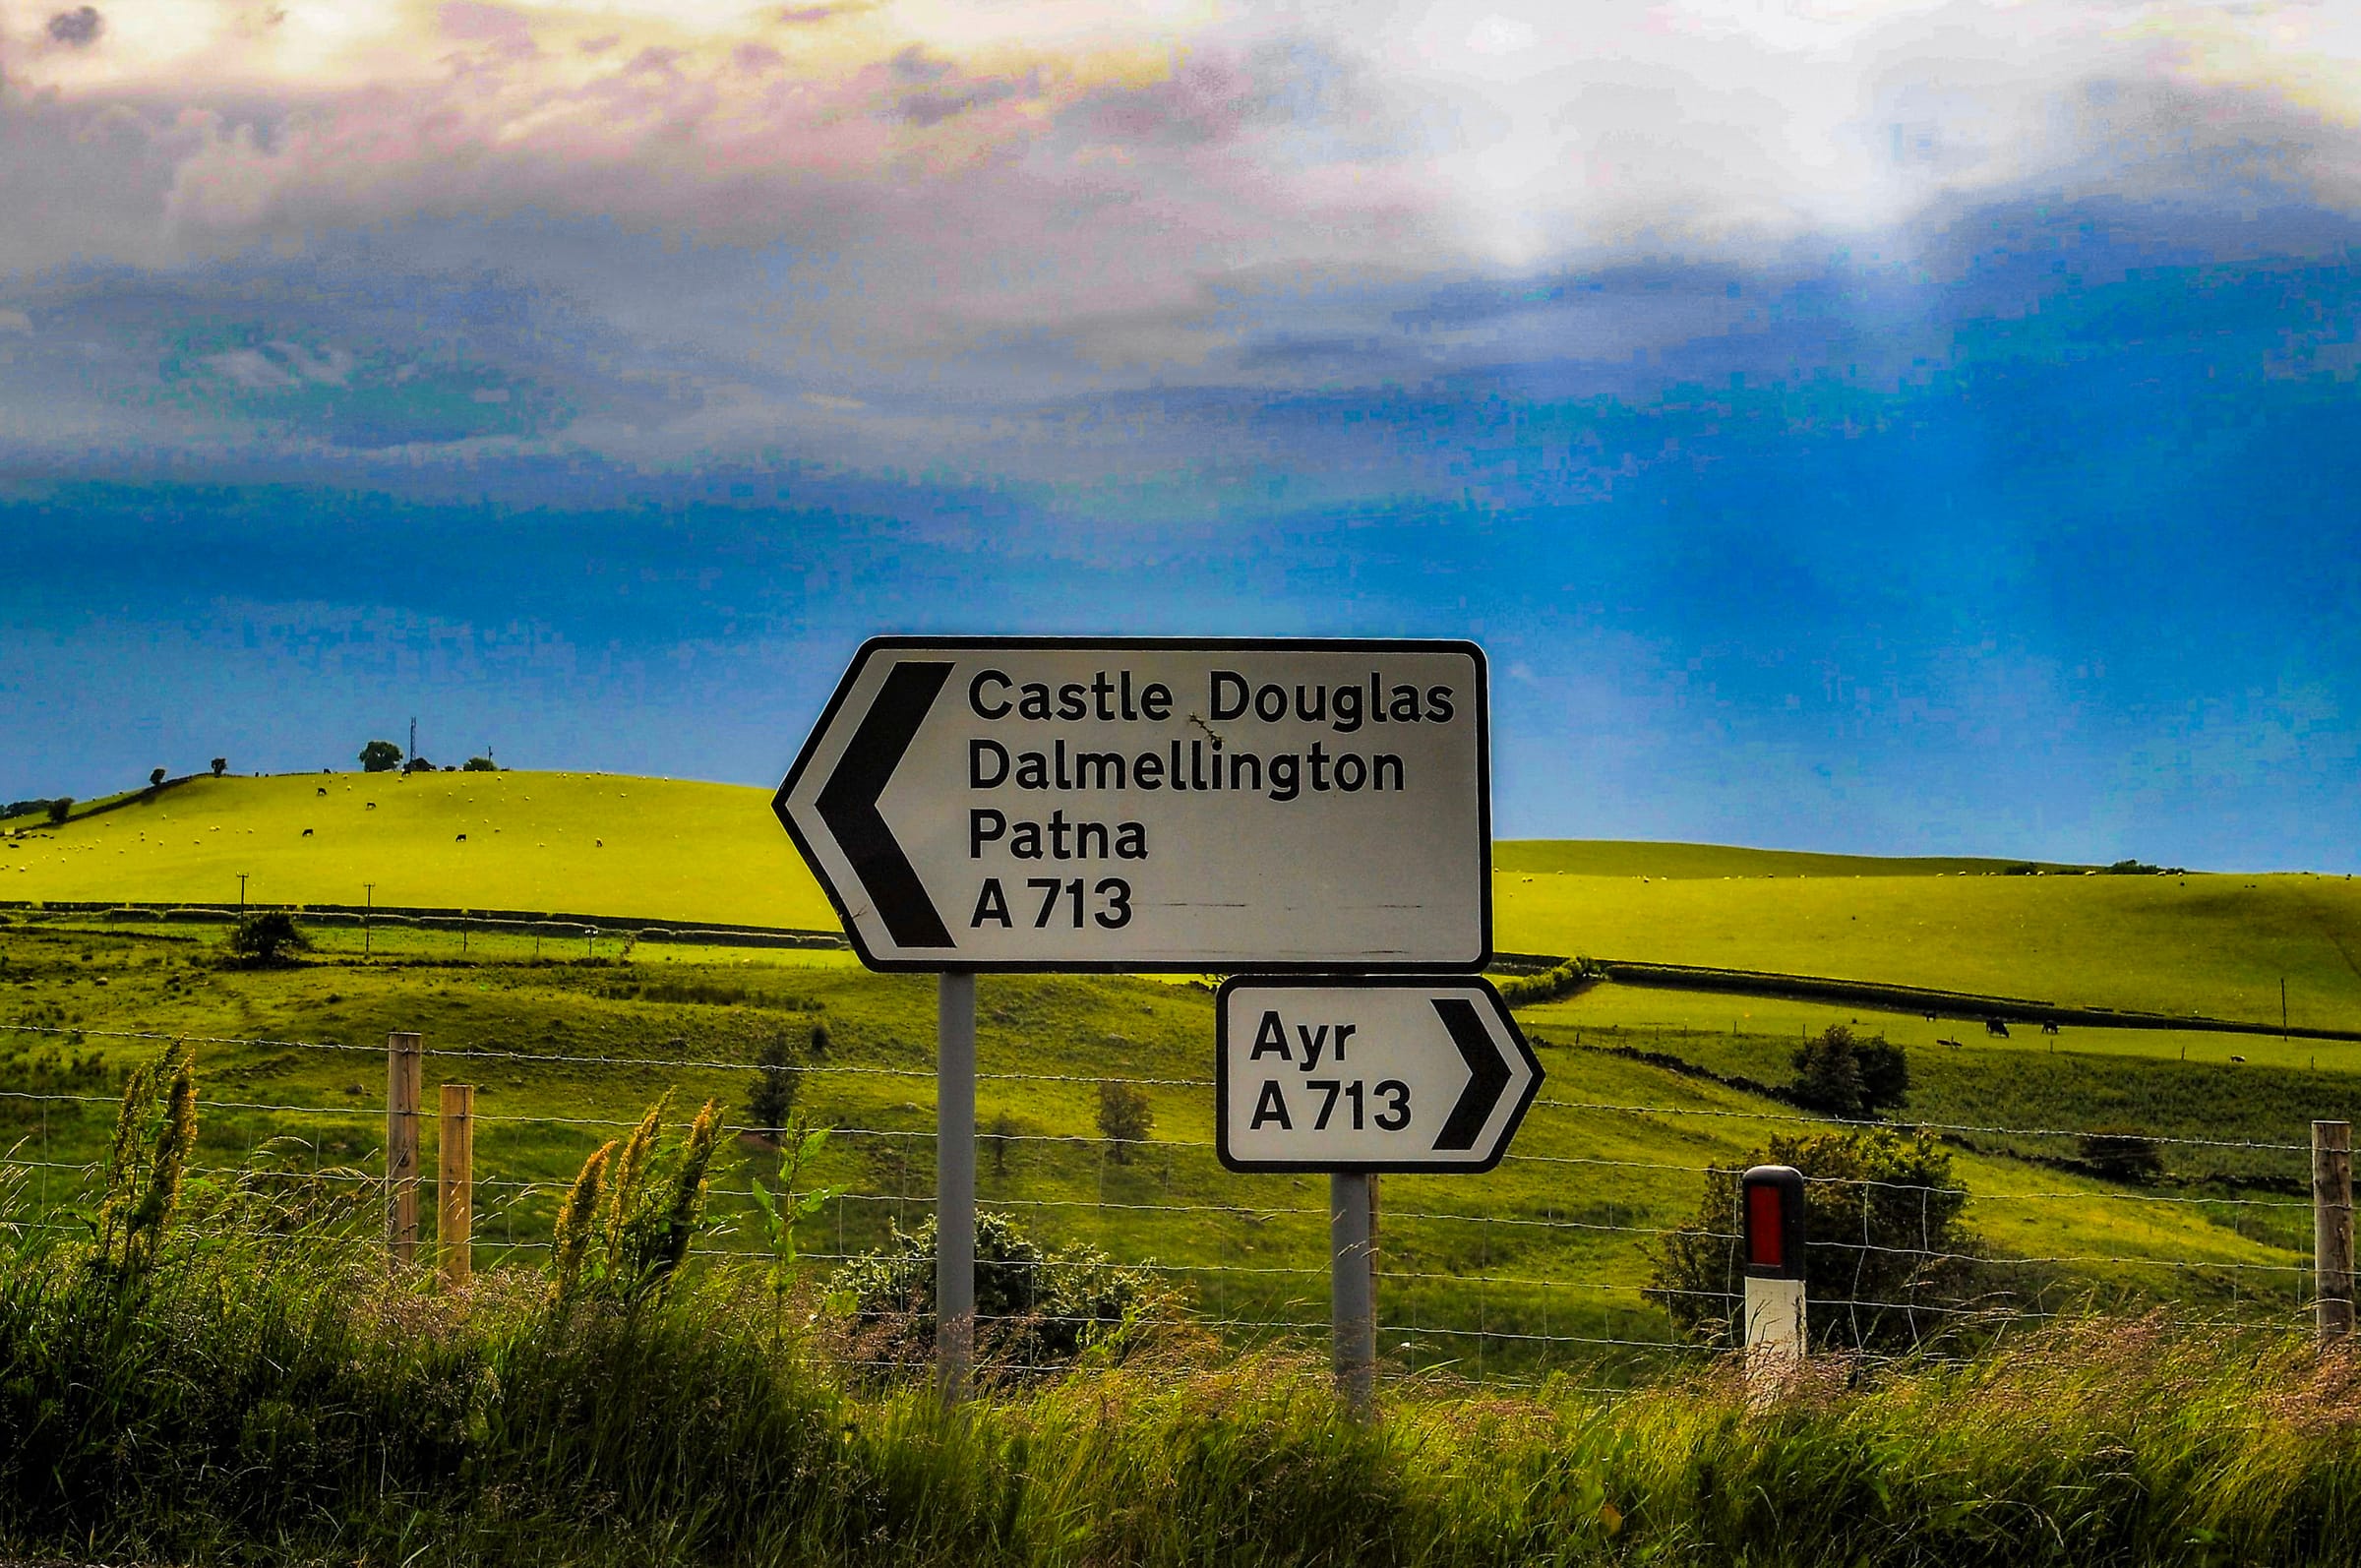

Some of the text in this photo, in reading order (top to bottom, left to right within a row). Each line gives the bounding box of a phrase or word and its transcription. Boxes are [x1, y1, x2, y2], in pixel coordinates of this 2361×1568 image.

[968, 669, 1455, 732] Castle Douglas
[968, 738, 1405, 802] Dalmellington
[968, 808, 1149, 860] Patna
[1249, 1010, 1358, 1072] Ayr
